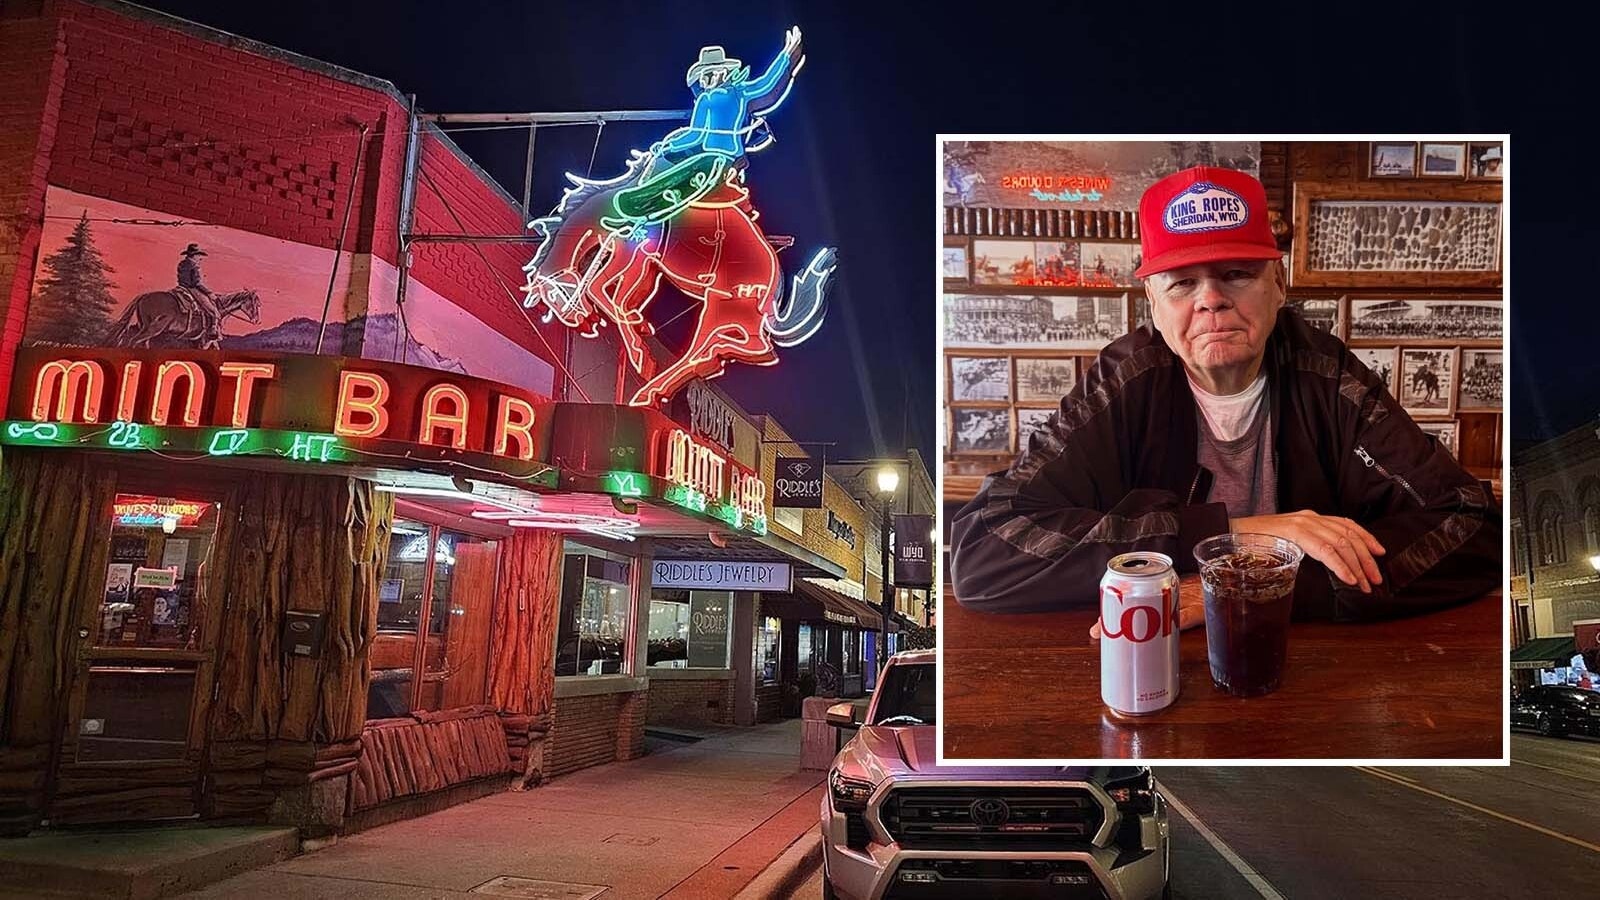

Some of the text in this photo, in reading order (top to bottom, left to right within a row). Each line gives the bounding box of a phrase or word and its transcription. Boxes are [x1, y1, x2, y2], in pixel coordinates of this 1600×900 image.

[1171, 197, 1240, 219] KING ROPES
[1172, 211, 1241, 228] SHERIDAN, WYO.
[32, 360, 535, 460] MINT BAR
[664, 428, 766, 518] MINT BAR
[776, 478, 821, 498] RIDDLE'S
[655, 562, 713, 583] RIDDLE'S
[717, 563, 775, 584] JEWELRY
